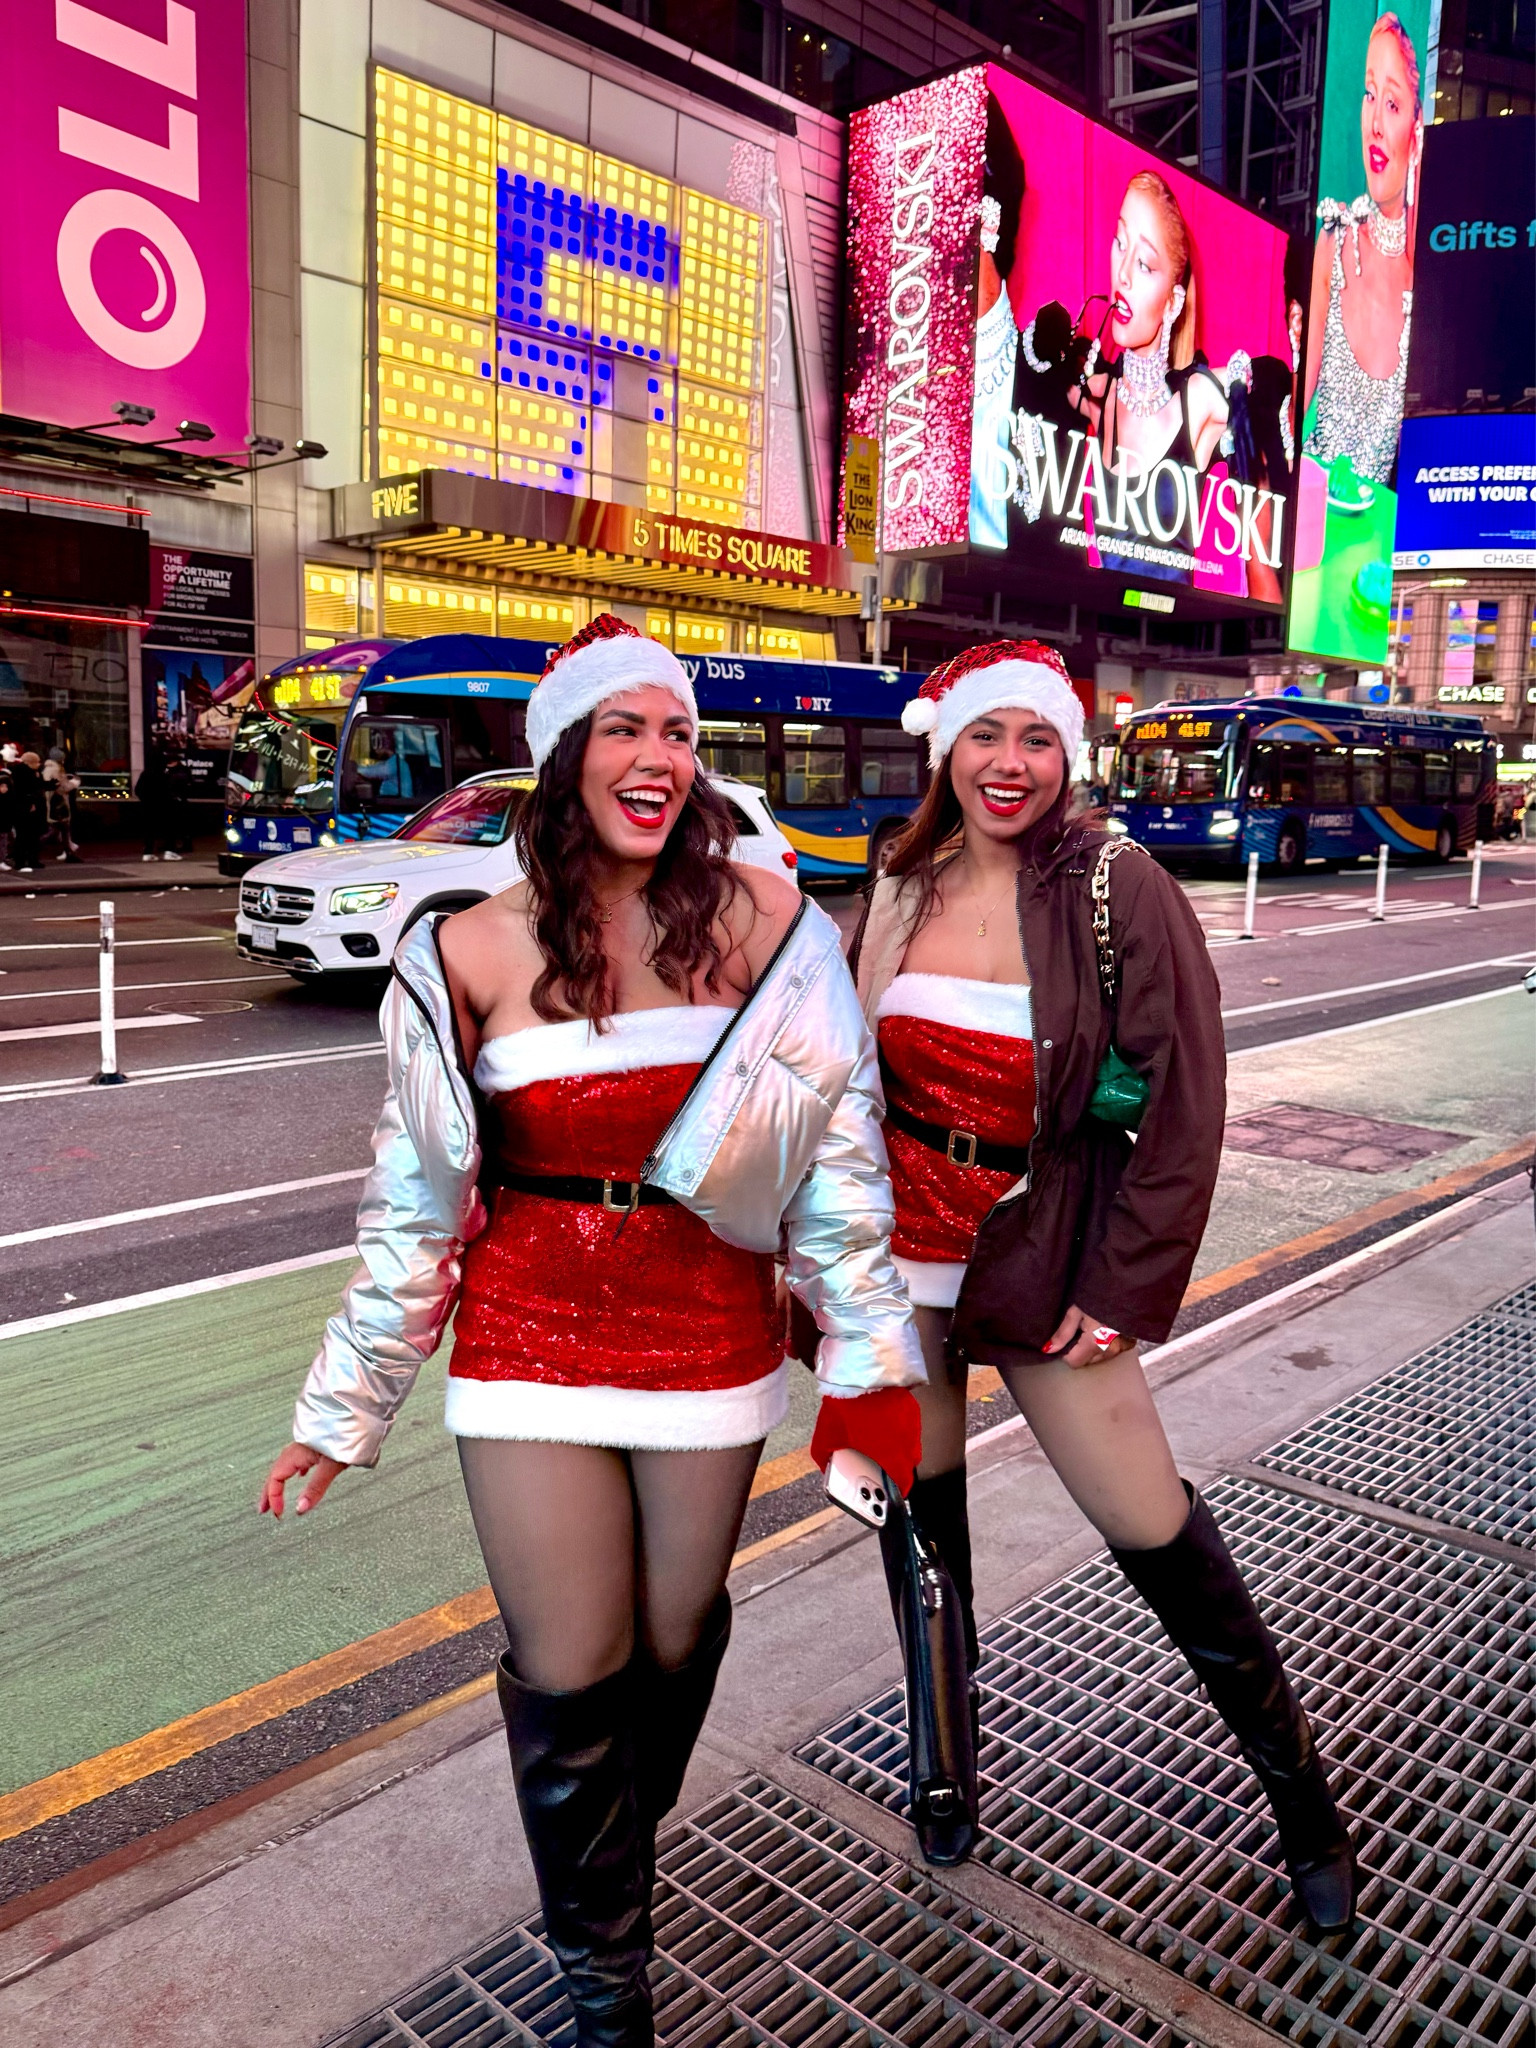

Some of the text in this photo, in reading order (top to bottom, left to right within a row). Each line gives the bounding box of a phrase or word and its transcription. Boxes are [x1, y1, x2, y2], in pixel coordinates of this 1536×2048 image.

[1429, 221, 1517, 253] Gifts
[885, 128, 936, 511] SWAROVSKI
[853, 473, 870, 487] THE
[1415, 466, 1480, 484] ACCESS
[980, 405, 1287, 569] SWAROVSKI
[1428, 487, 1476, 503] WITH
[1479, 486, 1528, 502] YOUR
[372, 482, 418, 519] FIVE
[849, 489, 873, 510] LION
[846, 512, 875, 535] KING
[633, 518, 812, 576] 5 TIMES SQUARE
[1060, 527, 1096, 548] ARIANA
[1097, 535, 1133, 557] GRANDE
[1134, 543, 1145, 559] IN
[163, 554, 182, 565] THE
[1483, 553, 1534, 565] CHASE
[163, 564, 232, 580] OPPORTUNITY
[163, 574, 231, 590] OF A LIFETIME
[705, 657, 745, 681] bus
[467, 682, 490, 693] 9807
[1438, 686, 1505, 702] CHASE
